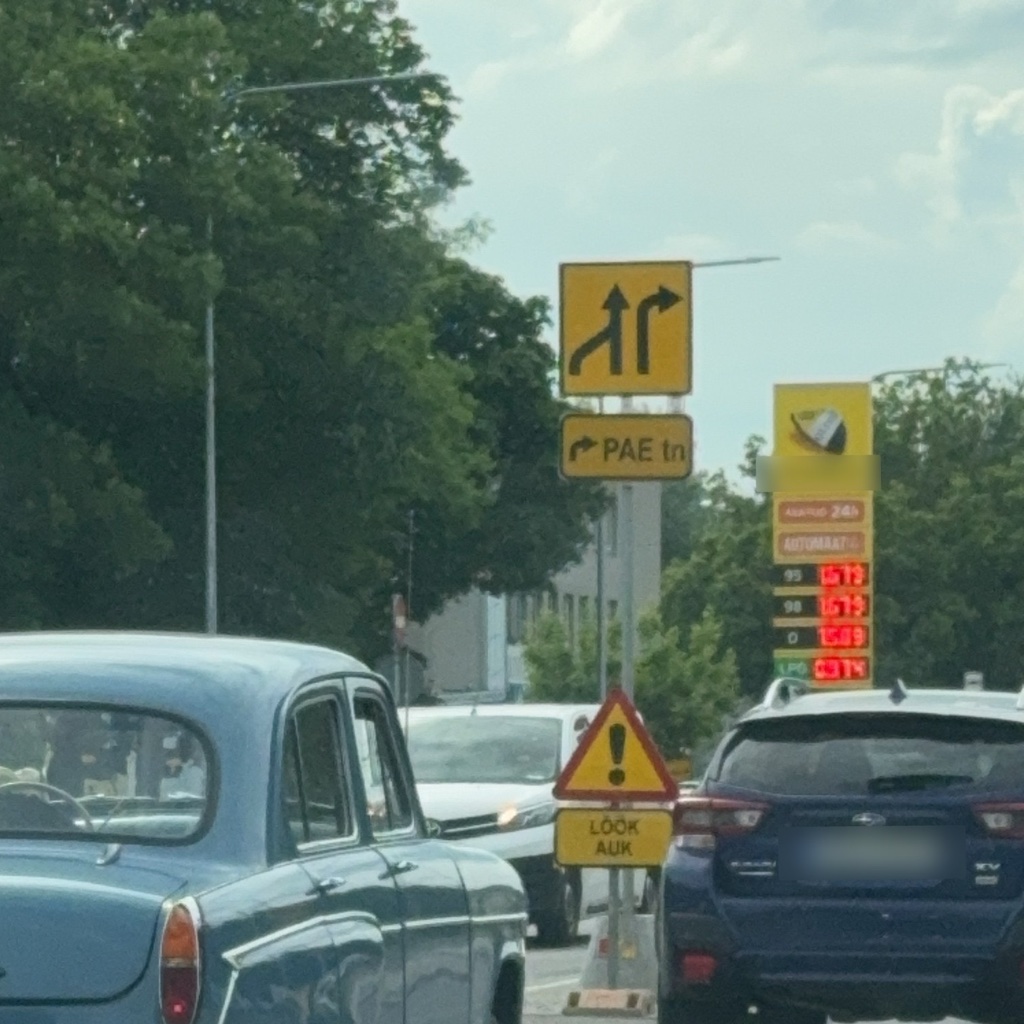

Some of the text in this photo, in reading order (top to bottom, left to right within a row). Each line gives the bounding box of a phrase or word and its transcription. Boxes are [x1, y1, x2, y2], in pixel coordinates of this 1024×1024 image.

[603, 437, 686, 462] PAE tn
[784, 568, 802, 582] 95
[784, 600, 802, 613] 98
[595, 839, 634, 856] AUK
